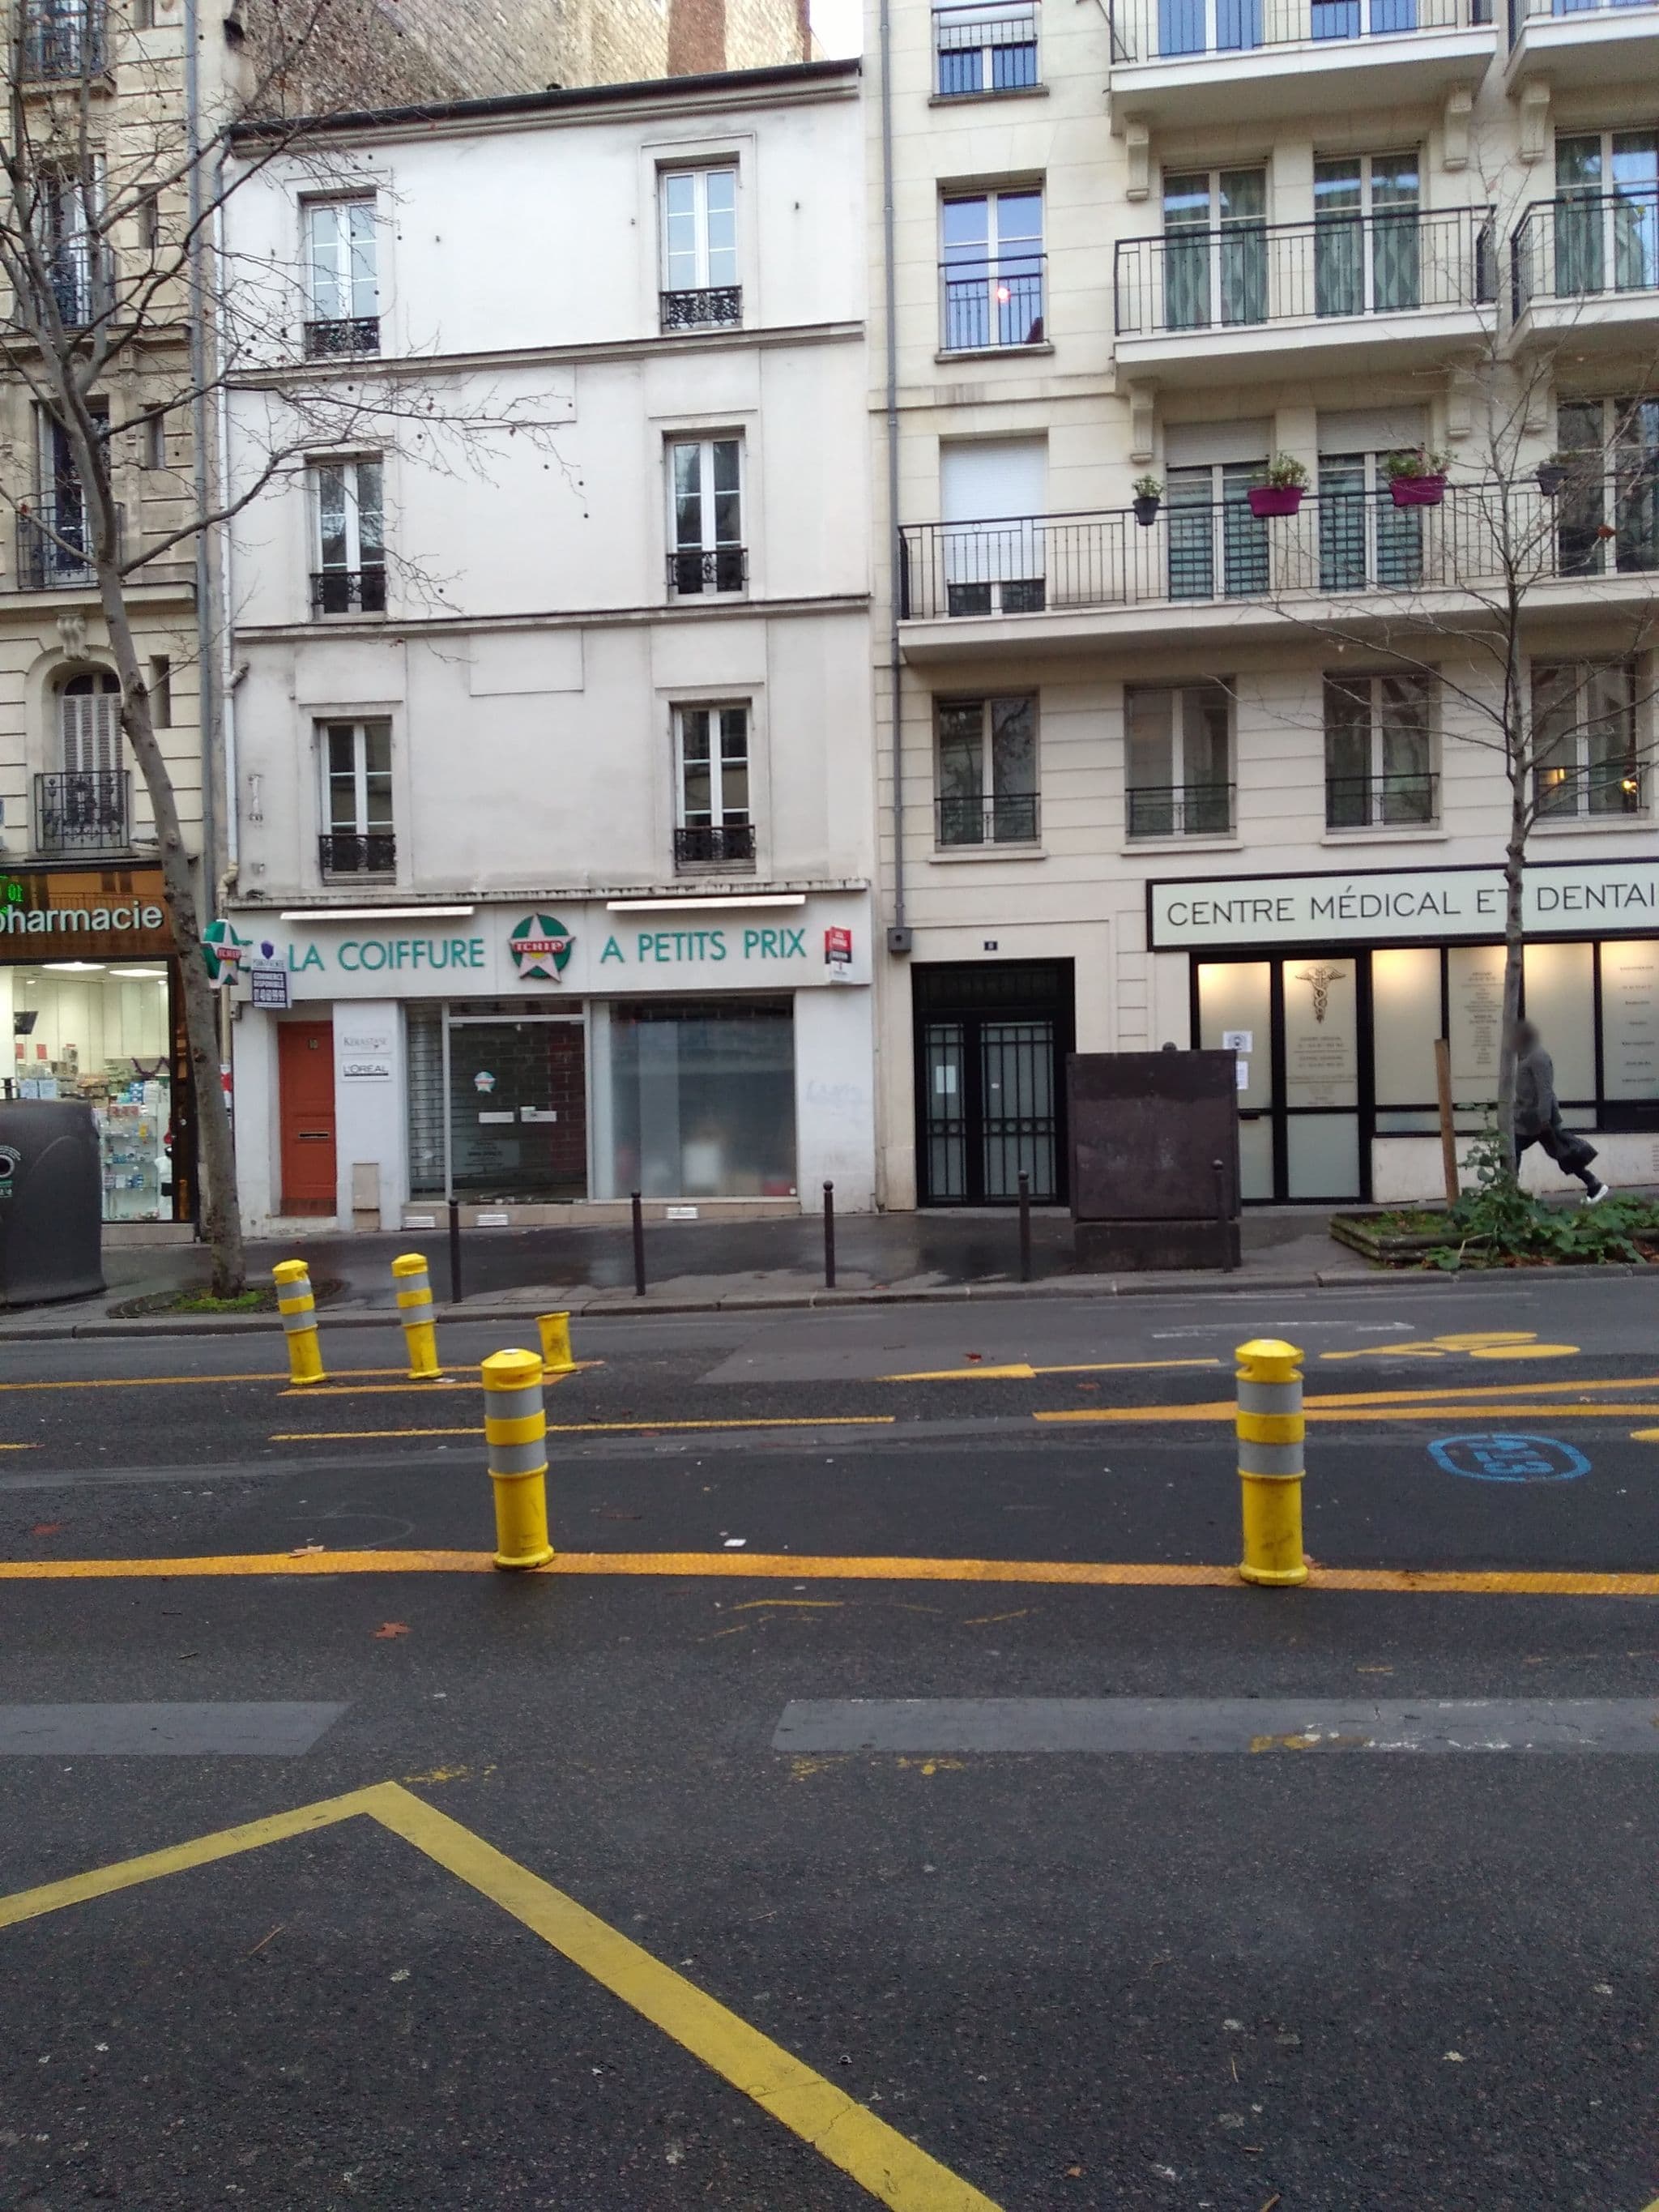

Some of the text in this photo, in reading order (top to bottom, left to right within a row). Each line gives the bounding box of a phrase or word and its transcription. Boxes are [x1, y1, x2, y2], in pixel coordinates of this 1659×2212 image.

[1167, 898, 1295, 926] CENTRE
[1310, 884, 1461, 920] MÉDICAL
[288, 942, 326, 971] LA
[337, 938, 485, 971] COIFFURE
[515, 942, 563, 951] TCHIP
[599, 929, 807, 964] A PETITS PRIX
